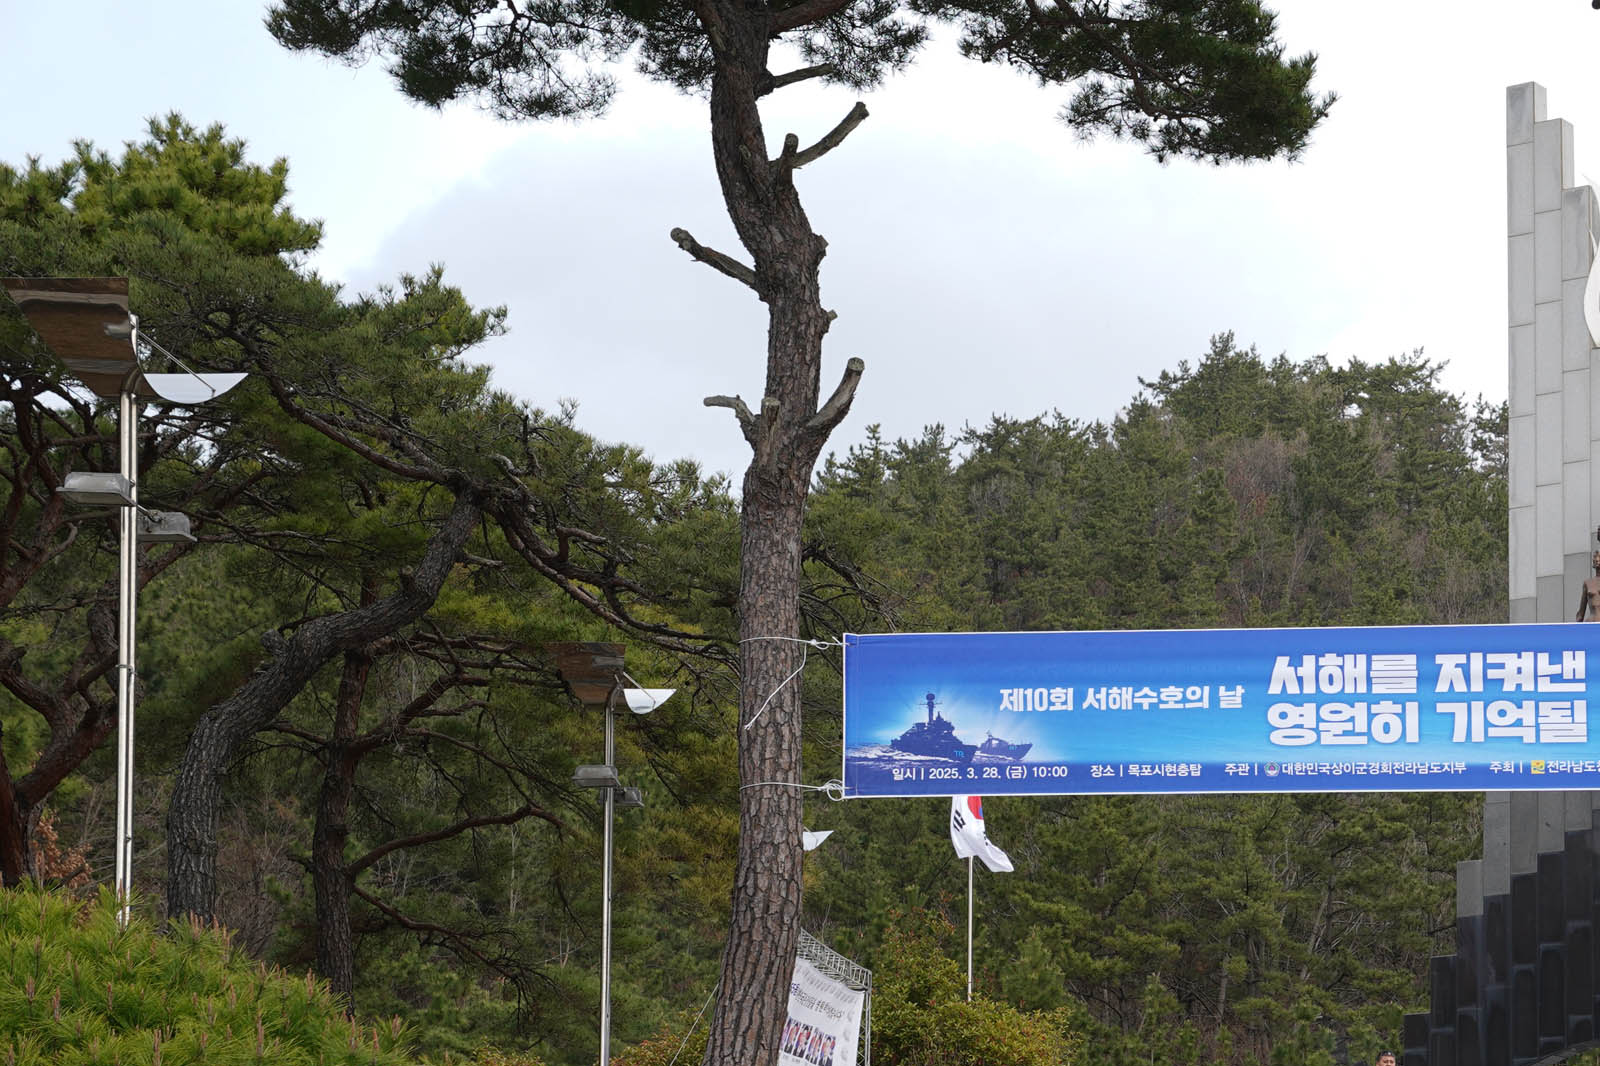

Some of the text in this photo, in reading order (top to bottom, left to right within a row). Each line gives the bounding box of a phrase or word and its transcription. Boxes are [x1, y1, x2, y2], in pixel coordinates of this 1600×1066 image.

[1268, 652, 1418, 695] 서해를
[1434, 650, 1586, 693] 지켜낸
[999, 684, 1245, 713] 제10회 서해수호의 날
[1267, 700, 1419, 745] 영원히
[1436, 698, 1587, 744] 기억될
[892, 765, 1068, 780] 일시 2025. 3. 28. (금) 10:00
[1090, 763, 1202, 778] 장소 목포시현충탑
[1224, 761, 1467, 776] 주관 대한민국상이군경회전라남도지부
[1489, 760, 1515, 774] 주최
